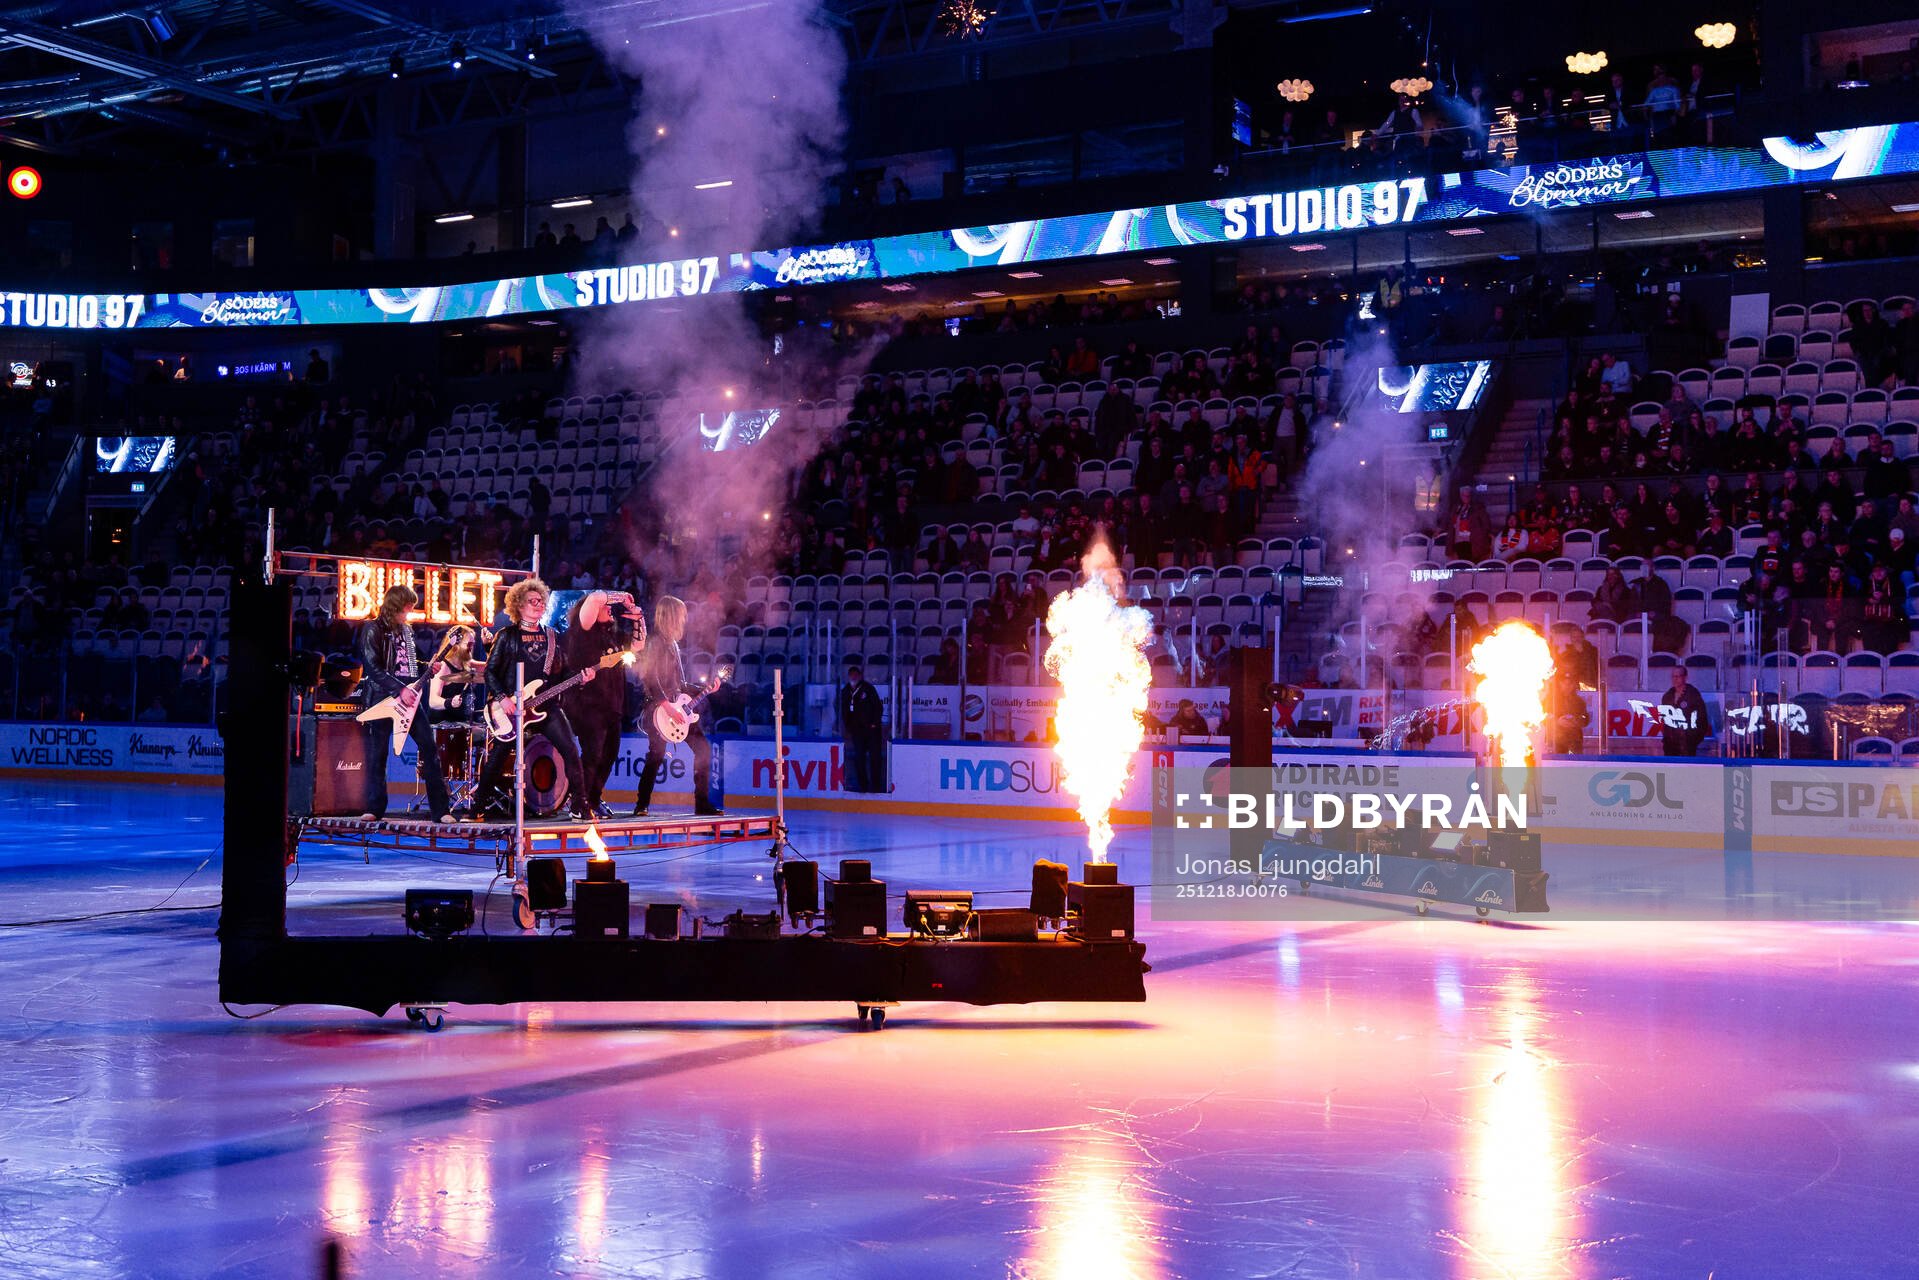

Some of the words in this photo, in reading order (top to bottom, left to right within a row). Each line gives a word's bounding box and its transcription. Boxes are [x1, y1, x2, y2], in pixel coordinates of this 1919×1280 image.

[1544, 163, 1623, 186] SÖDERS
[1509, 176, 1641, 207] Blommor
[1224, 181, 1362, 240] STUDIO
[1373, 177, 1426, 226] 97
[576, 261, 675, 307] STUDIO
[681, 256, 719, 295] 97
[105, 294, 145, 328] 97
[201, 301, 290, 324] Blommor
[225, 296, 278, 310] SÖDERS
[337, 560, 503, 627] BULLET
[30, 728, 97, 746] NORDIC
[12, 747, 113, 767] WELLNESS
[712, 743, 720, 790] CCM
[753, 745, 845, 791] nivik
[1158, 754, 1168, 808] CCM
[1272, 763, 1400, 786] YDTRADE
[1733, 769, 1745, 831] CCM
[1361, 875, 1385, 889] Linde
[1418, 881, 1439, 896] Linde
[1475, 890, 1503, 906] Linde
